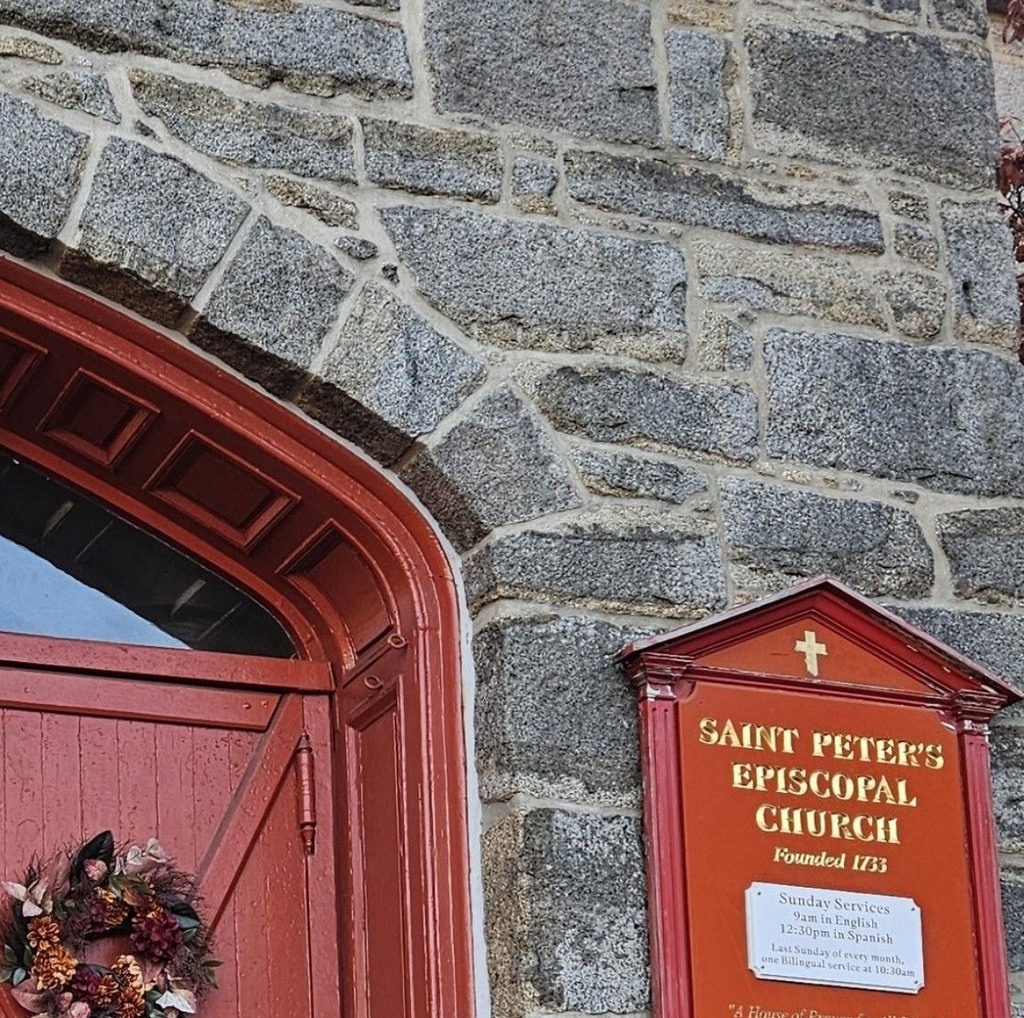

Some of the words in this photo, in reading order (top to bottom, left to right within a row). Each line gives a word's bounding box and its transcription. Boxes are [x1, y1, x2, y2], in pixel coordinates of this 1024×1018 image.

[699, 717, 800, 754] SAINT
[811, 730, 945, 770] PETER'S
[731, 761, 917, 808] EPISCOPAL
[755, 804, 901, 844] CHURCH
[773, 846, 845, 869] Founded
[852, 854, 888, 873] 1733
[779, 893, 831, 912] Sunday
[835, 899, 890, 914] Services
[794, 911, 817, 923] 9am
[821, 914, 832, 924] in
[835, 916, 878, 929] English
[780, 924, 830, 939] 12:30pm
[834, 929, 845, 939] in
[848, 930, 893, 944] Spanish
[771, 943, 792, 953] Last
[794, 945, 830, 958] Sunday
[832, 949, 842, 958] of
[844, 953, 869, 963] every
[871, 954, 905, 965] month,
[781, 957, 825, 970] Bilingual
[827, 963, 860, 972] service
[875, 965, 915, 977] 10:30am
[728, 1004, 743, 1018] "A
